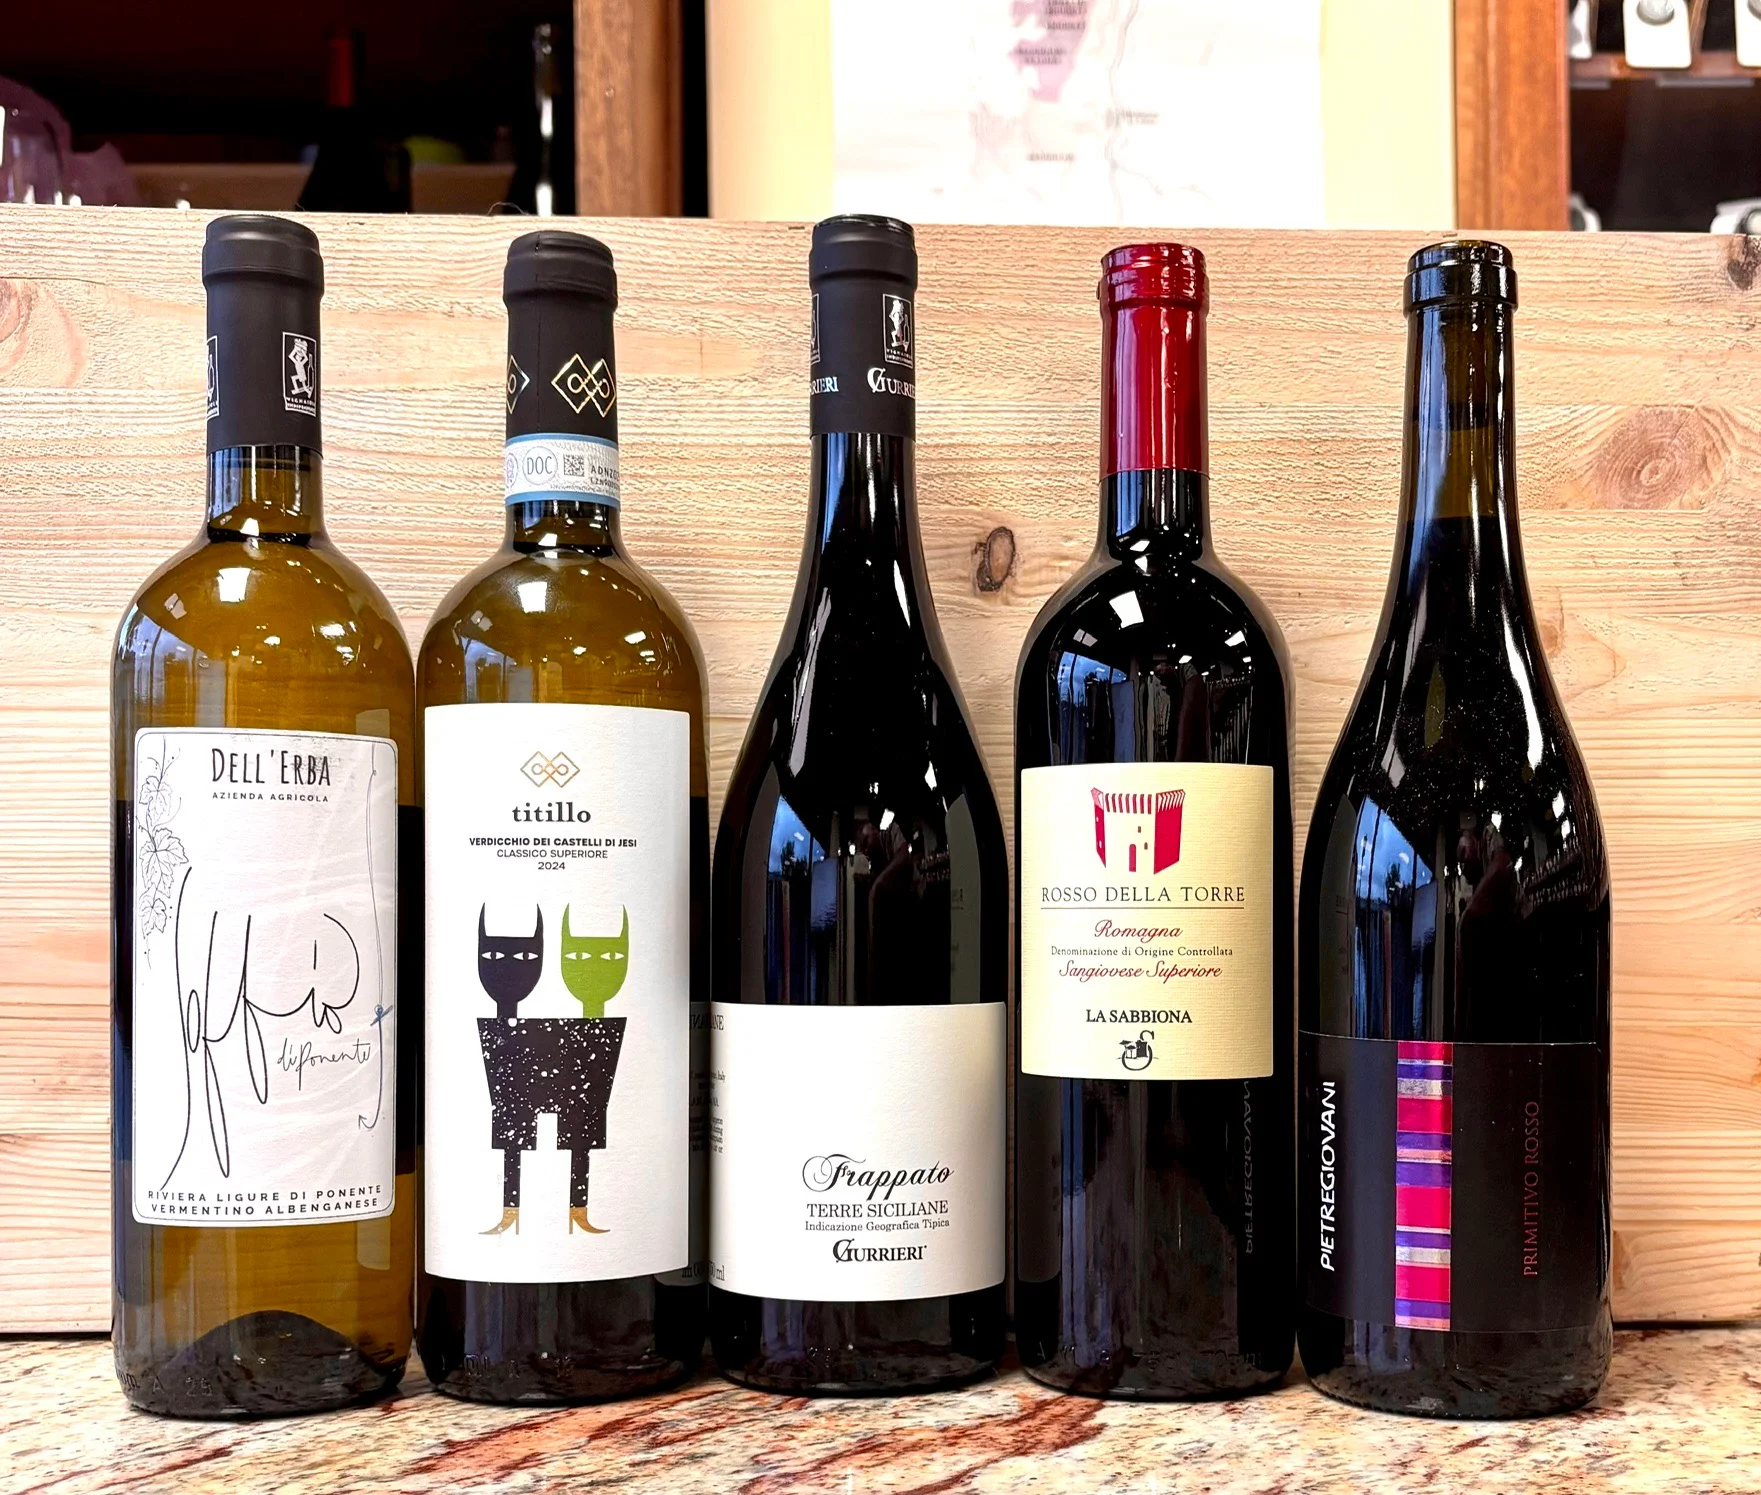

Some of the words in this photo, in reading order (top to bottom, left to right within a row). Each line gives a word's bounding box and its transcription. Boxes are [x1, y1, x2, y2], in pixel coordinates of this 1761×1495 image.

[809, 376, 839, 396] RIERI
[526, 455, 553, 475] DOC
[211, 748, 331, 786] DELL'ERBA
[212, 792, 264, 800] AZIENDA
[270, 793, 329, 803] AGRICOLA
[512, 801, 592, 823] titillo
[469, 837, 530, 846] VERDICCHIO
[533, 838, 551, 846] DEI
[553, 838, 602, 847] CASTELLI
[605, 838, 616, 847] DI
[618, 839, 637, 848] JESI
[497, 849, 548, 858] CLASSICO
[550, 849, 608, 859] SUPERIORE
[537, 861, 566, 870] 2024
[1042, 887, 1097, 902] ROSSO
[1106, 887, 1171, 902] DELLA
[1180, 887, 1245, 902] TORRE
[1094, 919, 1183, 943] Romagna
[1051, 946, 1118, 956] Denominazione
[1121, 946, 1132, 956] di
[1134, 946, 1174, 958] Origine
[1177, 946, 1233, 956] Controllata
[1059, 960, 1144, 983] Sangiovese
[1146, 960, 1223, 984] Superiore
[1086, 1009, 1107, 1023] LA
[1109, 1010, 1193, 1024] SABBIONA
[1524, 1101, 1539, 1165] ROSSO
[802, 1153, 955, 1201] Frappato
[1320, 1081, 1336, 1272] PIETREGIOVANI
[148, 1191, 206, 1202] RIVIERA
[216, 1192, 280, 1202] LIGURE
[290, 1191, 306, 1200] DI
[316, 1185, 381, 1199] PONENTE
[151, 1204, 255, 1215] VERMENTINO
[265, 1198, 378, 1214] ALBENGANESE
[806, 1203, 863, 1218] TERRE
[866, 1200, 949, 1217] SICILIANE
[805, 1221, 863, 1231] Indicazione
[866, 1220, 920, 1232] Geografica
[922, 1218, 950, 1230] Tipica
[1523, 1172, 1539, 1277] PRIMITIVO
